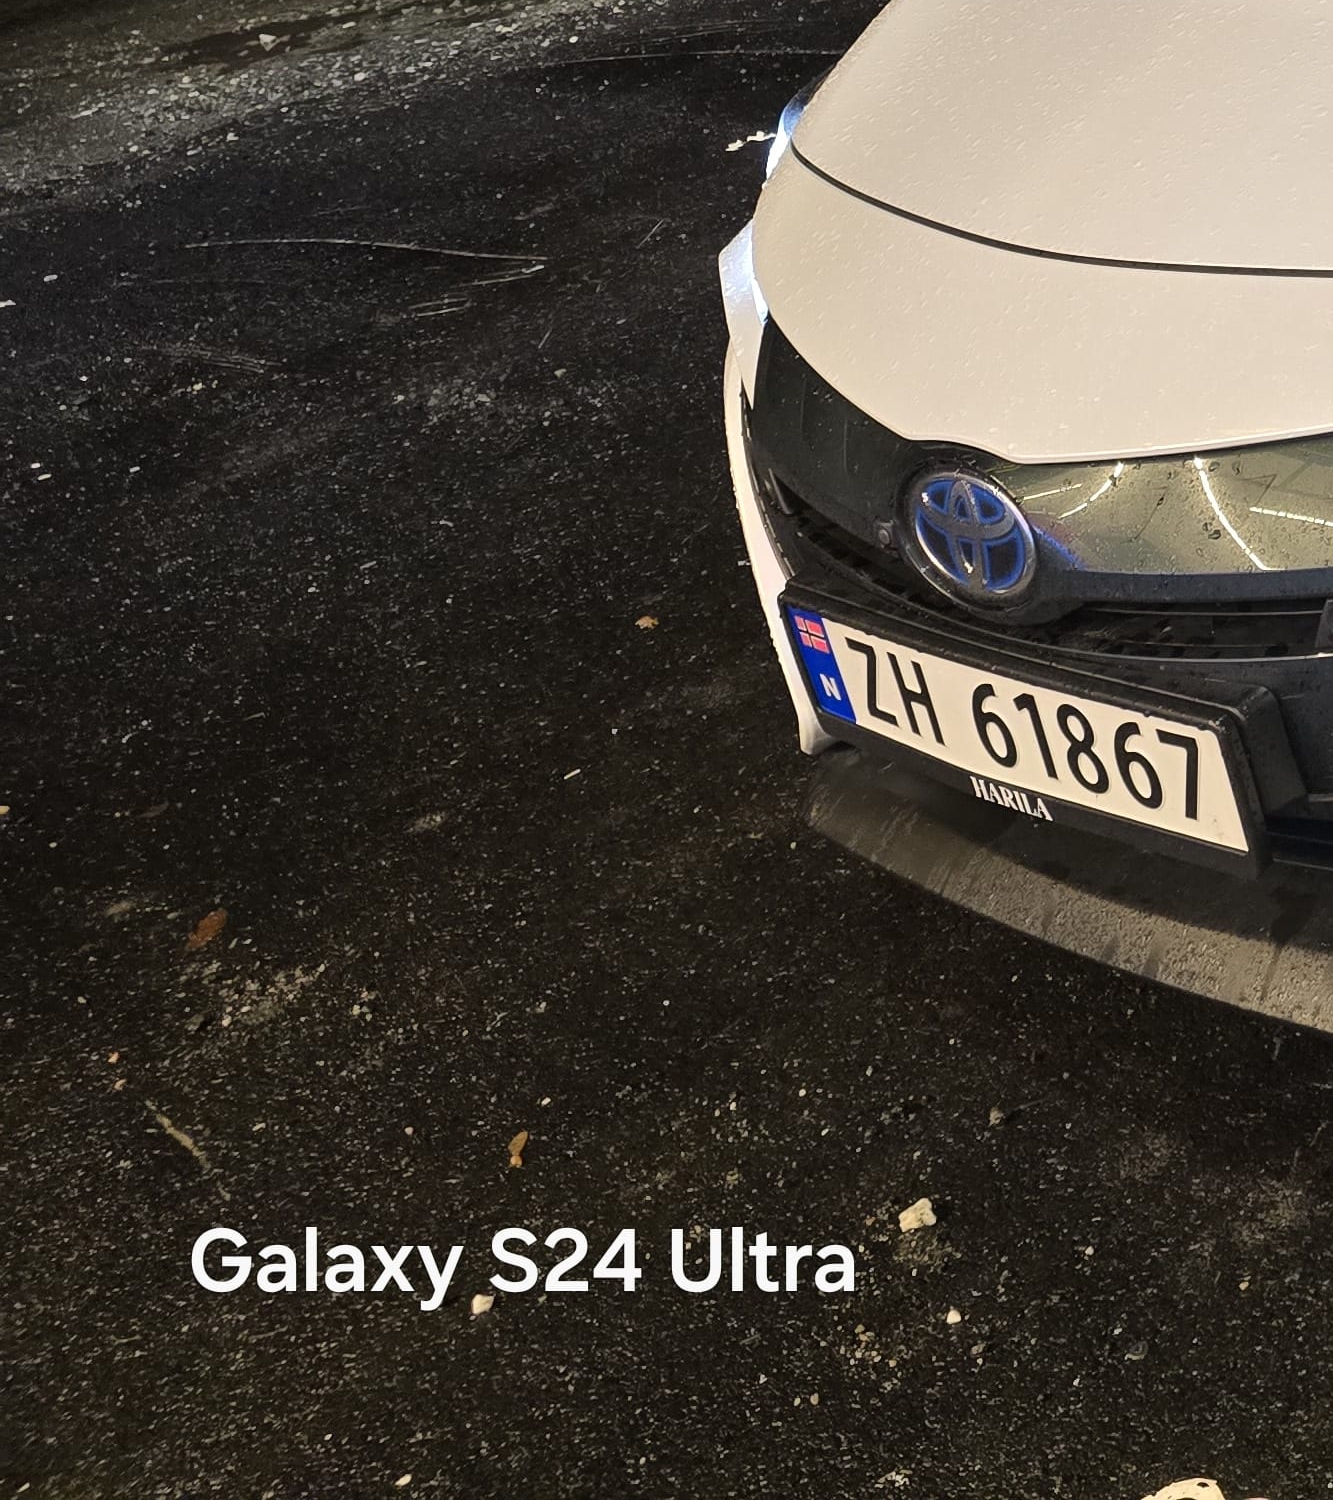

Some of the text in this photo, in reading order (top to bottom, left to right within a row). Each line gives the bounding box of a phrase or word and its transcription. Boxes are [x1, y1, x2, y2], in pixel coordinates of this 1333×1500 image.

[821, 673, 842, 701] N
[844, 636, 1202, 821] ZH 61867
[969, 775, 1054, 822] HARILA
